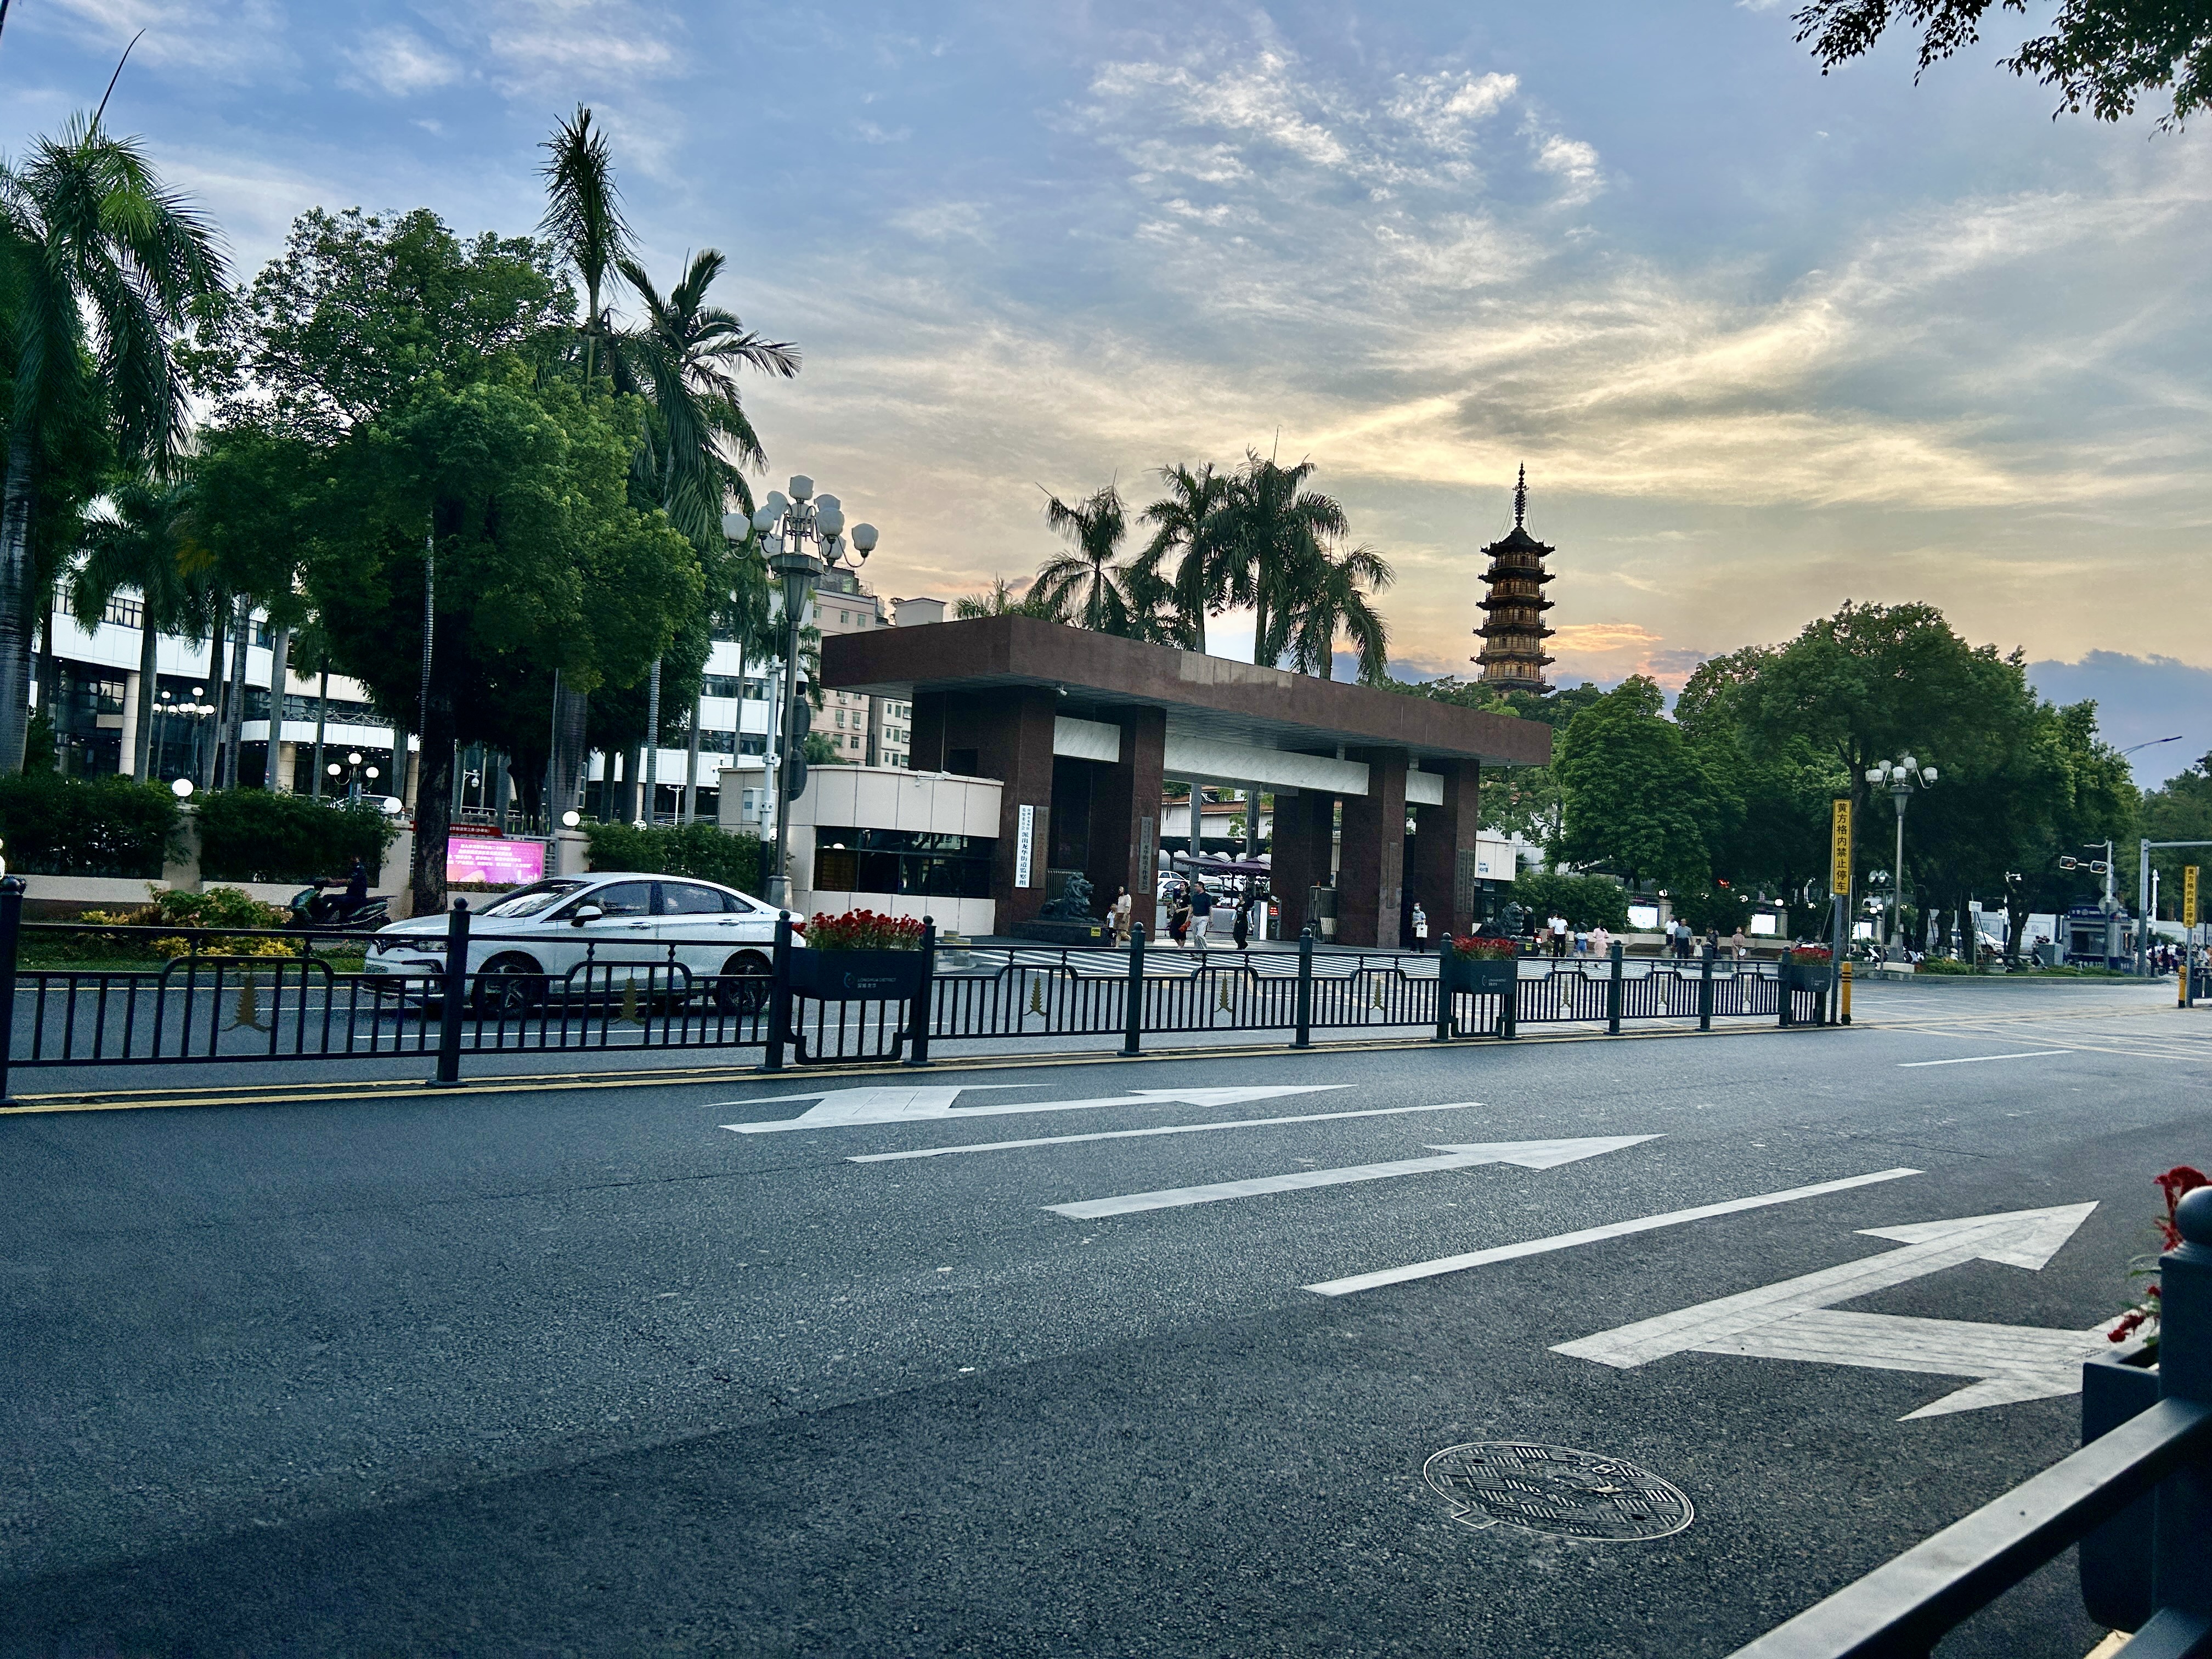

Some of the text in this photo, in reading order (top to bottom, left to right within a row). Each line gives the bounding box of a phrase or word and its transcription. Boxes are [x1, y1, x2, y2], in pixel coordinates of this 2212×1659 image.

[1836, 803, 1847, 891] 黄方格内禁止停车
